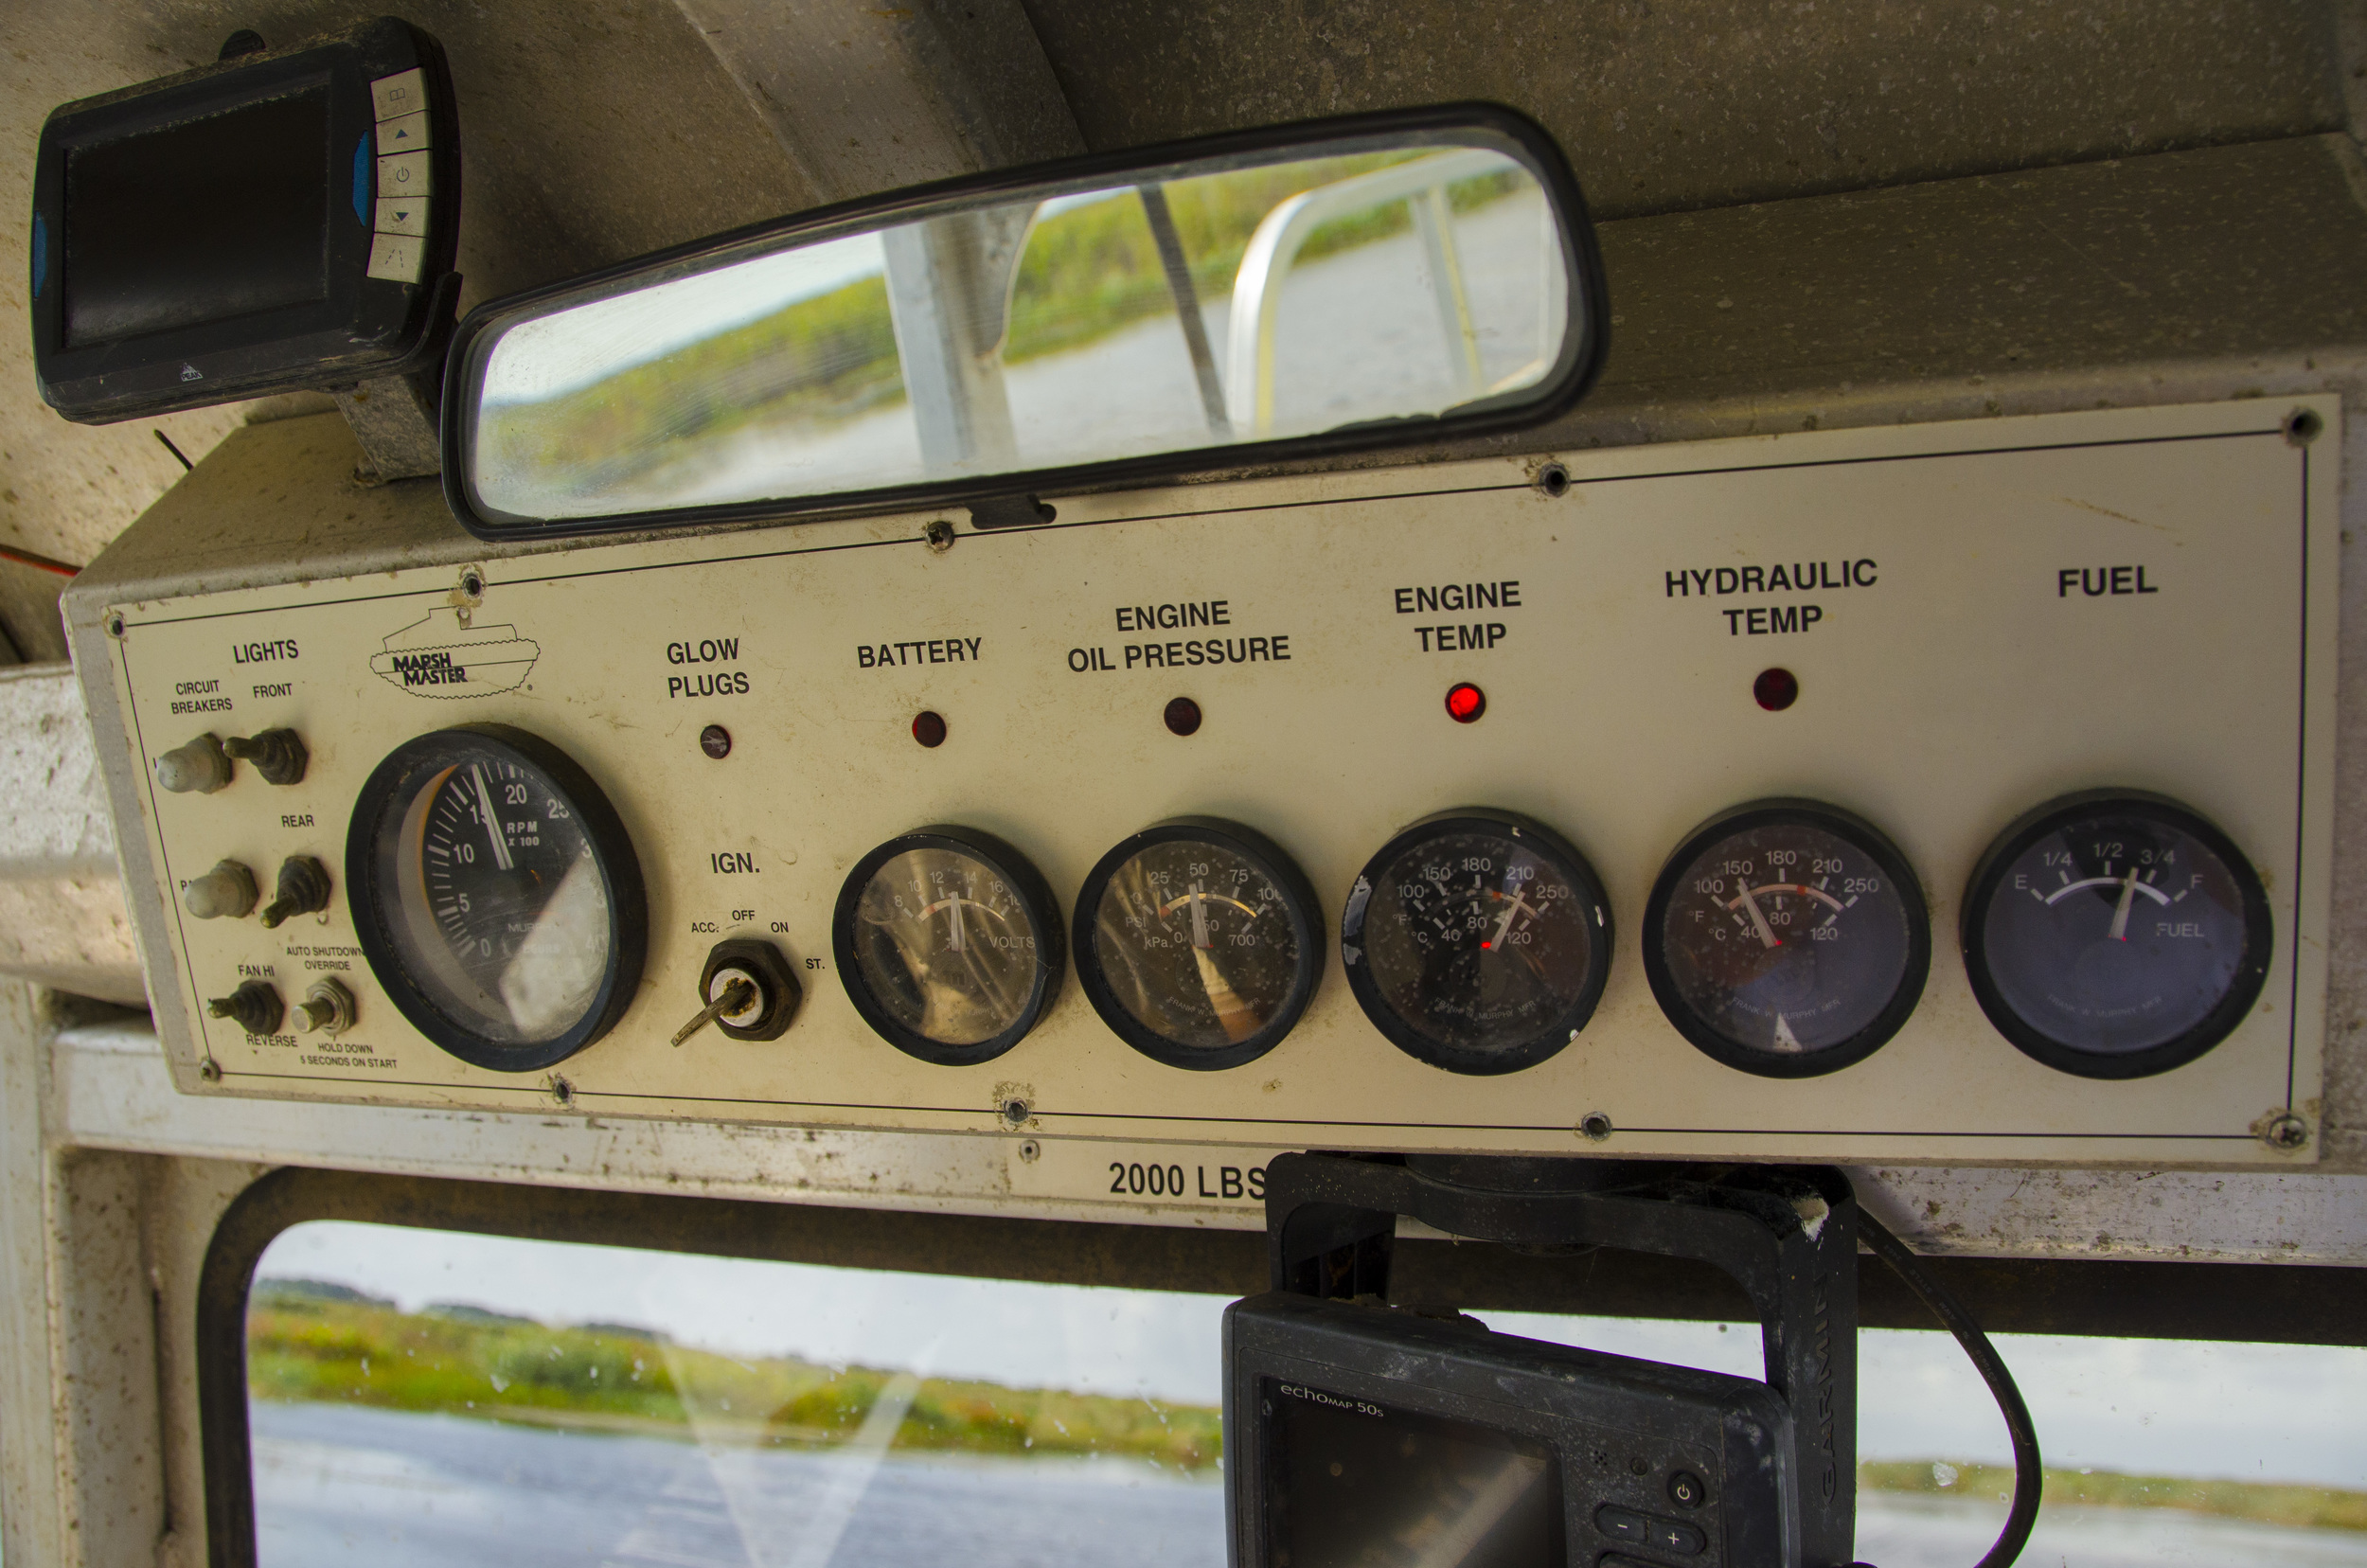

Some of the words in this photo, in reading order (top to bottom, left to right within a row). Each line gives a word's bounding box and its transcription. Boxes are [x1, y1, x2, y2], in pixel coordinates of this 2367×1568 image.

[181, 371, 202, 381] PEAK
[1664, 558, 1878, 597] HYDRAULIC
[2058, 565, 2159, 597] FUEL
[1394, 580, 1522, 614] ENGINE
[1115, 599, 1231, 632] ENGINE
[1722, 605, 1824, 636] TEMP
[1415, 622, 1507, 652] TEMP
[233, 639, 299, 664] LIGHTS
[667, 637, 739, 665] GLOW
[857, 636, 983, 668] BATTERY
[1067, 646, 1116, 673] OIL
[1124, 634, 1292, 670] PRESSURE
[392, 652, 453, 672] MARSH
[402, 667, 469, 686] MASTER
[176, 680, 220, 695] CIRCUIT
[253, 683, 293, 699] FRONT
[667, 671, 750, 699] PLUGS
[171, 698, 233, 715] BREAKERS
[505, 783, 527, 804] 20
[546, 798, 570, 819] 25
[281, 814, 314, 828] REAR
[507, 821, 538, 833] RPM
[520, 837, 540, 846] 100
[454, 844, 474, 864] 10
[1765, 850, 1797, 865] 180
[2093, 842, 2124, 859] 1/2
[2140, 849, 2176, 864] 3/4
[711, 852, 760, 874] IGN.
[1462, 857, 1491, 872] 180
[2043, 850, 2073, 867] 1/4
[1189, 863, 1209, 877] 50
[1422, 866, 1451, 882] 150
[1505, 866, 1534, 881] 210
[1722, 860, 1753, 875] 150
[1812, 859, 1843, 874] 210
[929, 871, 945, 884] 12
[963, 871, 978, 884] 14
[1150, 871, 1169, 884] 25
[1229, 868, 1249, 882] 75
[2015, 874, 2028, 890] E
[2191, 874, 2204, 889] F
[907, 880, 922, 893] 10
[988, 881, 1004, 894] 16
[1397, 884, 1425, 899] 100
[1536, 885, 1569, 900] 250
[1694, 879, 1724, 894] 100
[1843, 878, 1879, 893] 250
[459, 893, 471, 913] 5
[894, 895, 904, 908] 8
[1131, 892, 1143, 905] 0
[732, 910, 756, 921] OFF
[1125, 917, 1147, 928] PSI
[1392, 914, 1408, 926] °F
[1688, 910, 1704, 923] °F
[1769, 912, 1791, 925] 80
[691, 922, 720, 933] ACC.
[771, 921, 790, 933] ON
[1467, 917, 1487, 930] 80
[2156, 922, 2205, 937] FUEL
[1174, 931, 1184, 943] 0
[1411, 931, 1428, 944] °C
[1441, 930, 1461, 942] 40
[1505, 932, 1532, 944] 120
[1708, 928, 1726, 941] °C
[1740, 926, 1762, 939] 40
[1810, 927, 1839, 940] 120
[481, 938, 491, 957] 0
[989, 935, 1036, 949] VOLTS
[1144, 936, 1168, 948] kPa
[1229, 934, 1256, 947] 700
[287, 946, 311, 956] AUTO
[313, 947, 365, 957] SHUTDOWN
[238, 965, 261, 976] FAN
[262, 966, 275, 977] HI
[304, 960, 351, 971] OVERRIDE
[806, 958, 826, 970] ST.
[1168, 996, 1196, 1012] FRANK
[1434, 997, 1461, 1015] FRANK
[1478, 1008, 1514, 1020] MURPHY
[1518, 1000, 1537, 1014] MFR
[1731, 996, 1761, 1015] FRANK
[245, 1034, 298, 1047] REVERSE
[318, 1042, 343, 1053] HOLD
[345, 1043, 374, 1054] DOWN
[300, 1055, 306, 1064] 5
[307, 1056, 350, 1067] SECONDS
[352, 1058, 365, 1068] ON
[367, 1059, 398, 1069] START
[1109, 1162, 1184, 1197] 2000
[1198, 1166, 1266, 1201] LBS
[1814, 1271, 1837, 1505] GARMIN
